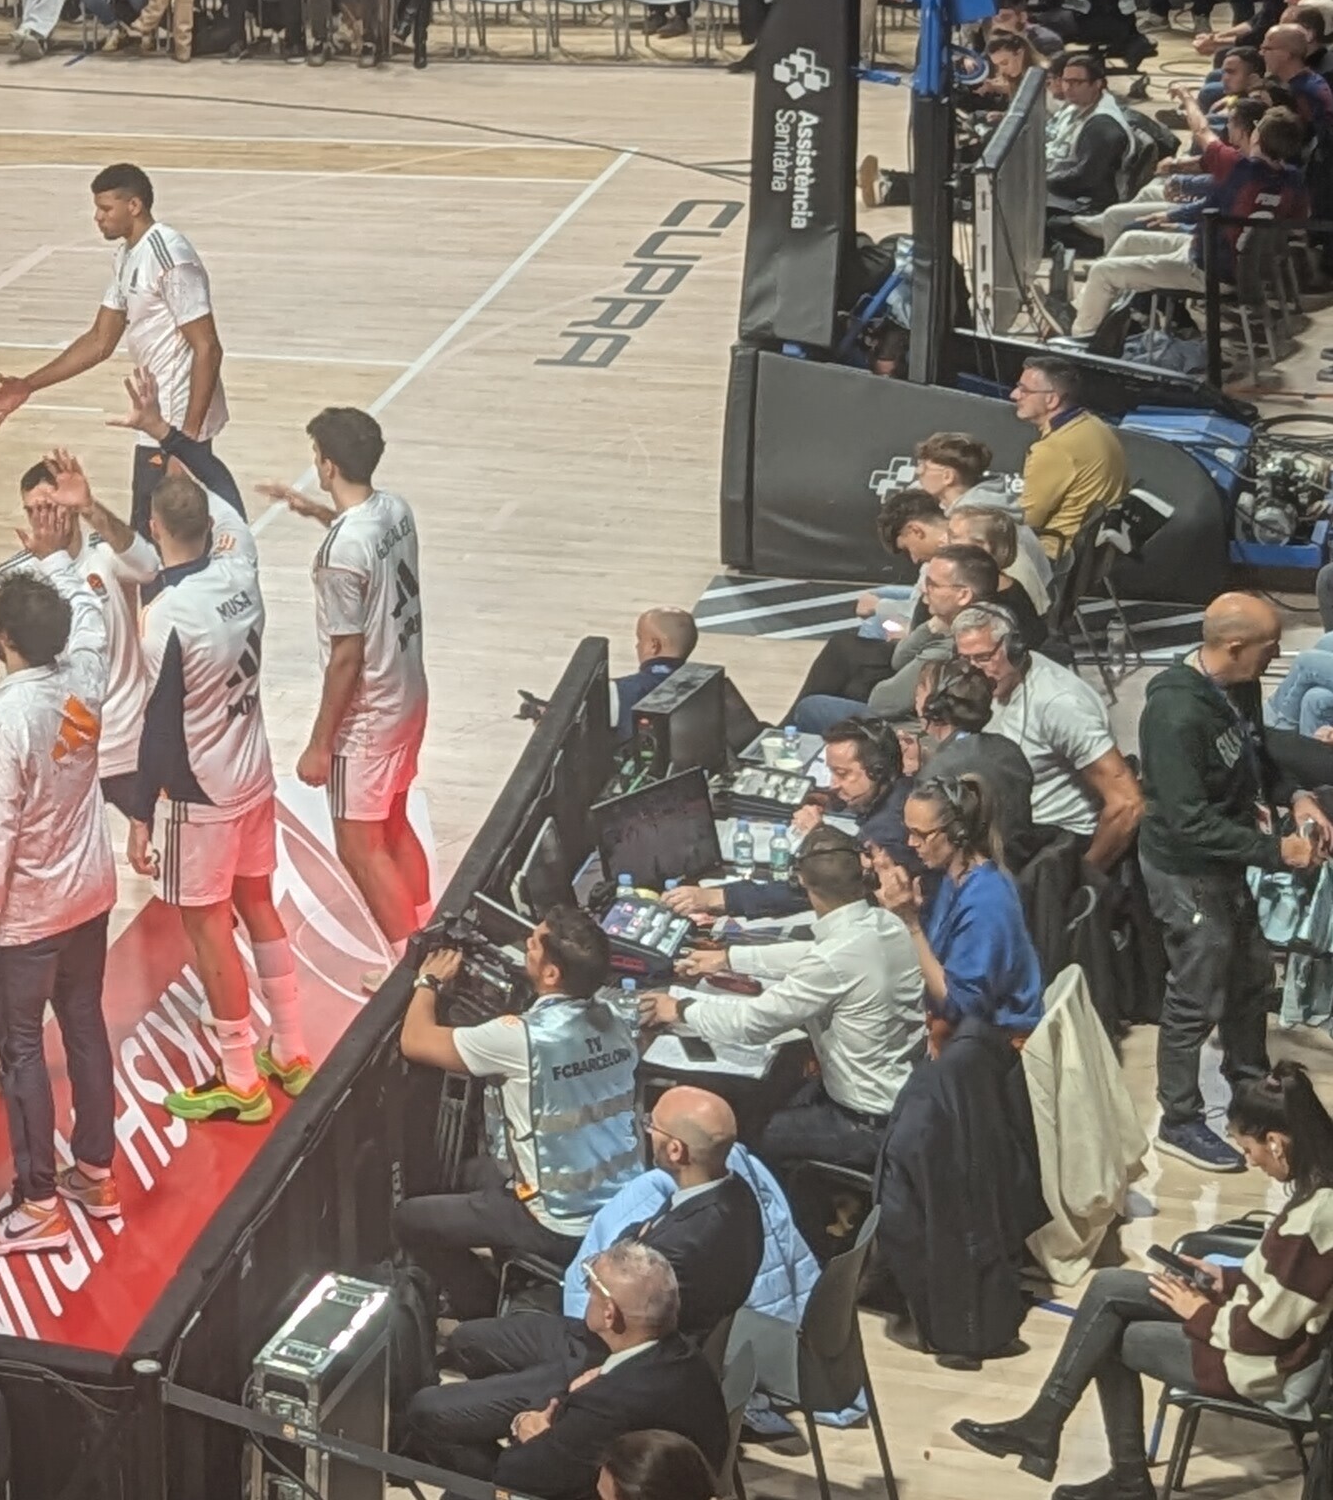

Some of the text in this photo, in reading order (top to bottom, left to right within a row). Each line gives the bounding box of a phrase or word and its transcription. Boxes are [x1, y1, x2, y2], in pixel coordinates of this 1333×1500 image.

[791, 109, 820, 230] Assistència
[533, 199, 746, 368] CUPRA
[215, 589, 253, 623] MUSA
